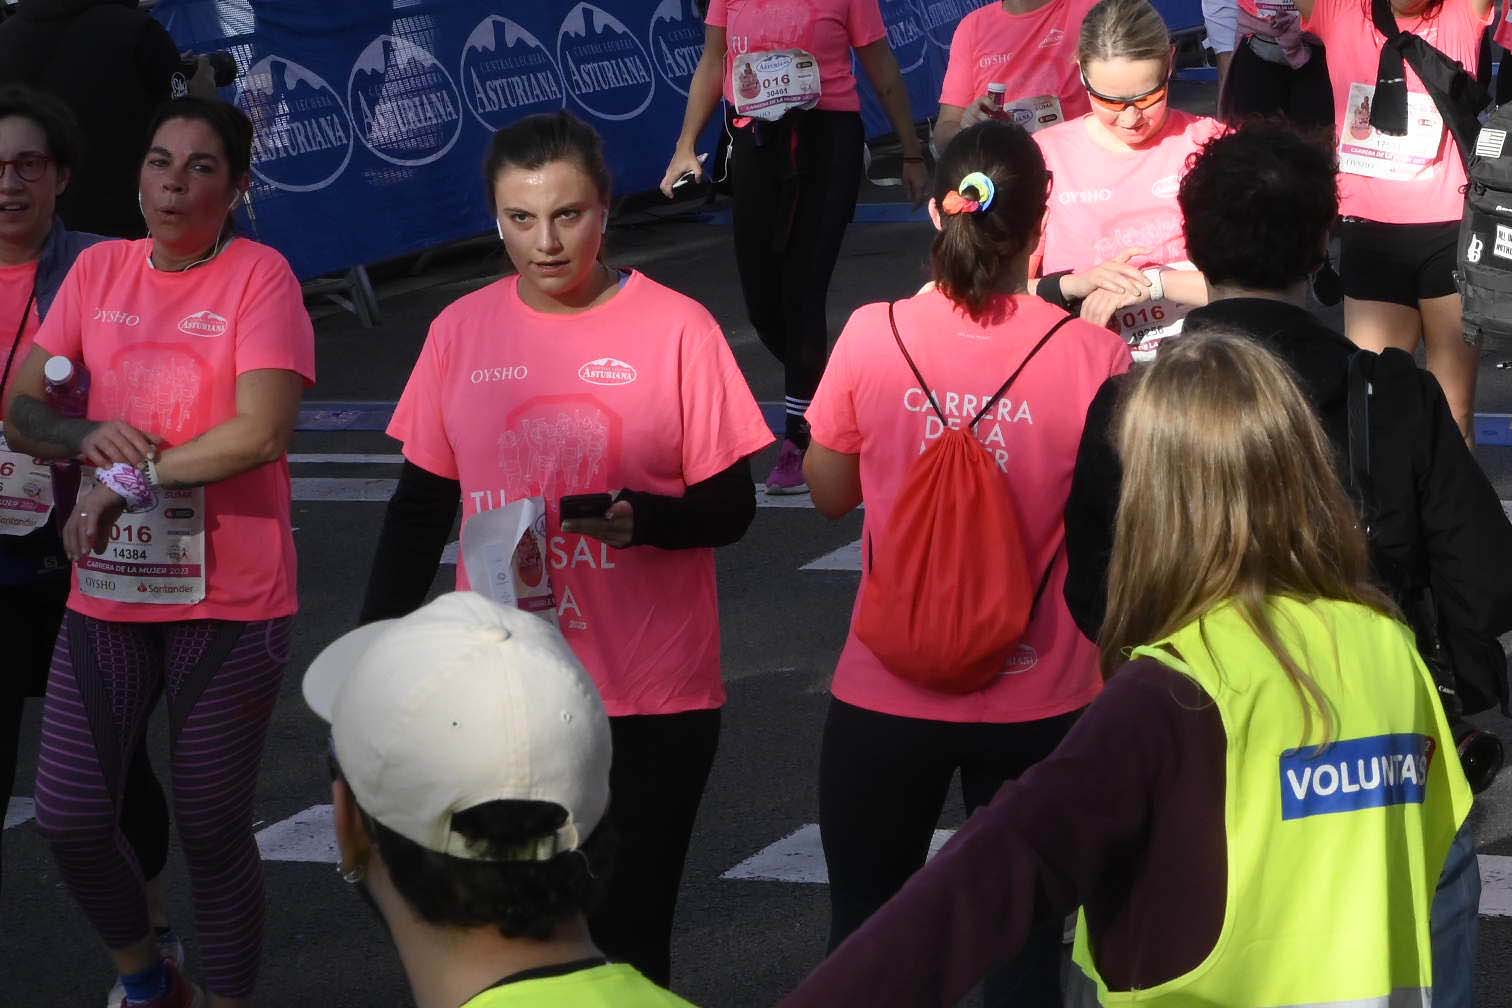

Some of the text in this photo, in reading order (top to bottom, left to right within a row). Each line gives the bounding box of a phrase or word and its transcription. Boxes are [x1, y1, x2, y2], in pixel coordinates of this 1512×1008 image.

[566, 49, 652, 96] ASTURIANA
[470, 65, 563, 115] ASTURIANA
[763, 74, 791, 89] 016
[358, 90, 459, 142] ASTURIANA
[1058, 188, 1112, 205] OYSHO
[92, 305, 141, 328] OYSHO
[1123, 305, 1165, 328] 016
[182, 318, 227, 333] ASTURIANA
[471, 365, 528, 385] OYSHO
[582, 368, 635, 381] ASTURIANA
[904, 386, 1033, 426] CARRERA
[0, 516, 36, 527] antander
[109, 524, 152, 543] 016
[113, 547, 147, 561] 14384
[86, 560, 189, 576] CARRERA DE LA MUJER 2023
[85, 578, 116, 592] OYSHO
[148, 584, 193, 594] Santander
